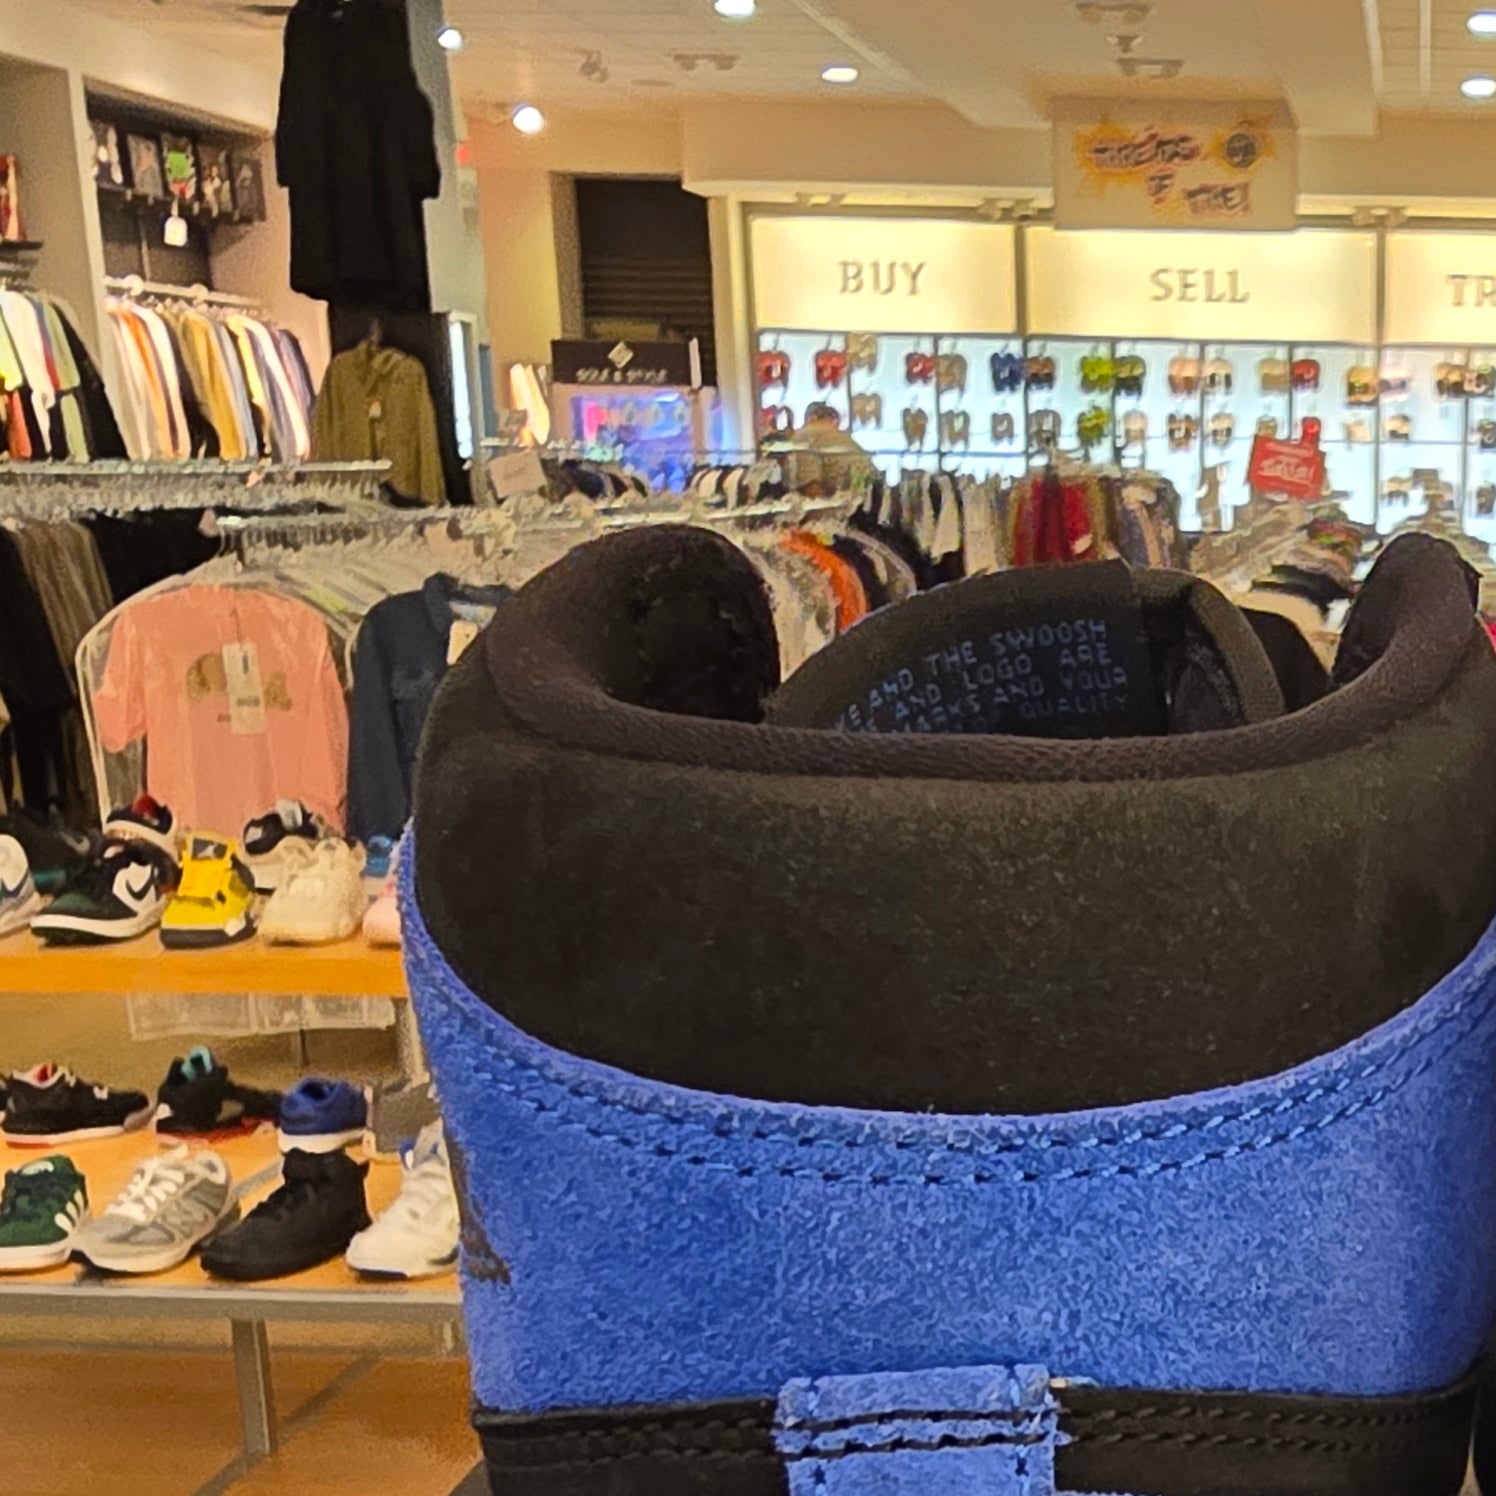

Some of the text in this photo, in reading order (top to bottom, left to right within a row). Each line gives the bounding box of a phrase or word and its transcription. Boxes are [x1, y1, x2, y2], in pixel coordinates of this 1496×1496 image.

[837, 259, 927, 296] BUY
[1149, 268, 1251, 304] SELL
[926, 640, 977, 677] THE
[990, 618, 1106, 656] SWOOSH
[962, 653, 1032, 690] LOGO
[1060, 641, 1112, 668] ARE
[1020, 690, 1129, 719] QUALITY
